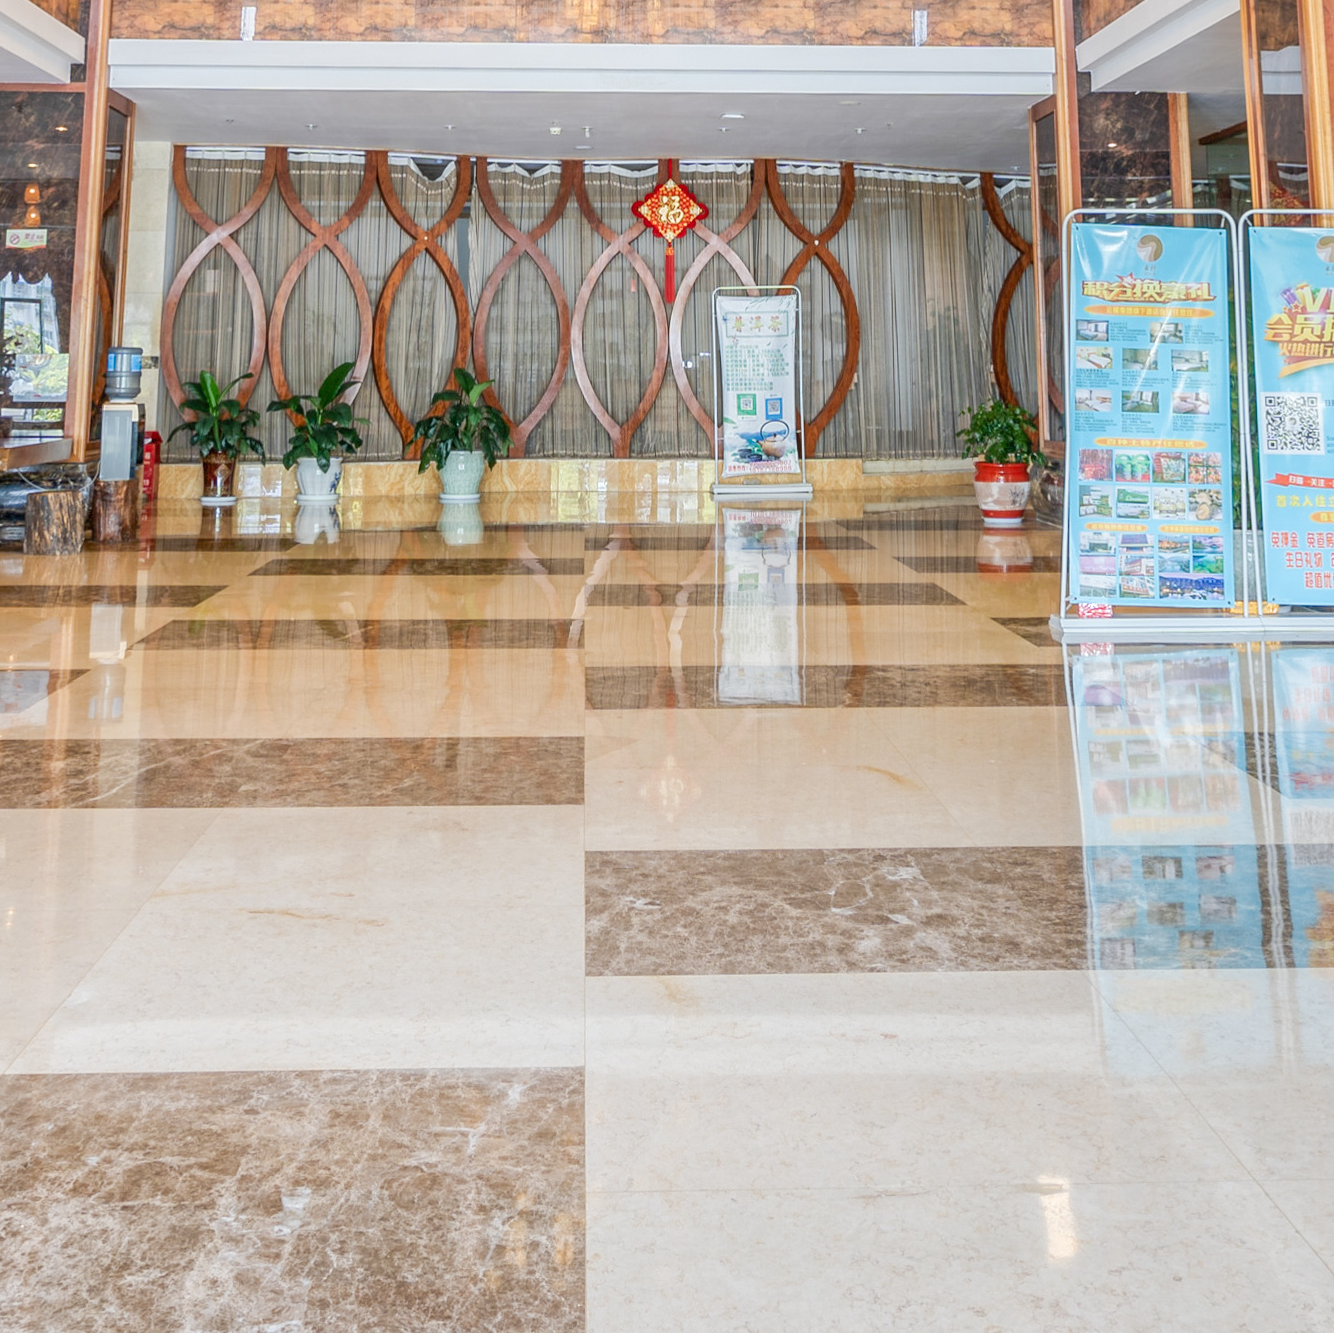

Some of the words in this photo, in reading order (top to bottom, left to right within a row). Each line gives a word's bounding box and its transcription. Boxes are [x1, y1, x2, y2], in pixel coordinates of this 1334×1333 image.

[658, 195, 684, 225] 福
[1082, 277, 1217, 304] 积分换豪礼
[732, 315, 782, 333] 普洱茶
[1310, 477, 1326, 486] 关注
[1271, 532, 1299, 548] 免押金
[1307, 532, 1334, 548] 免查房
[1285, 552, 1323, 568] 生日礼物
